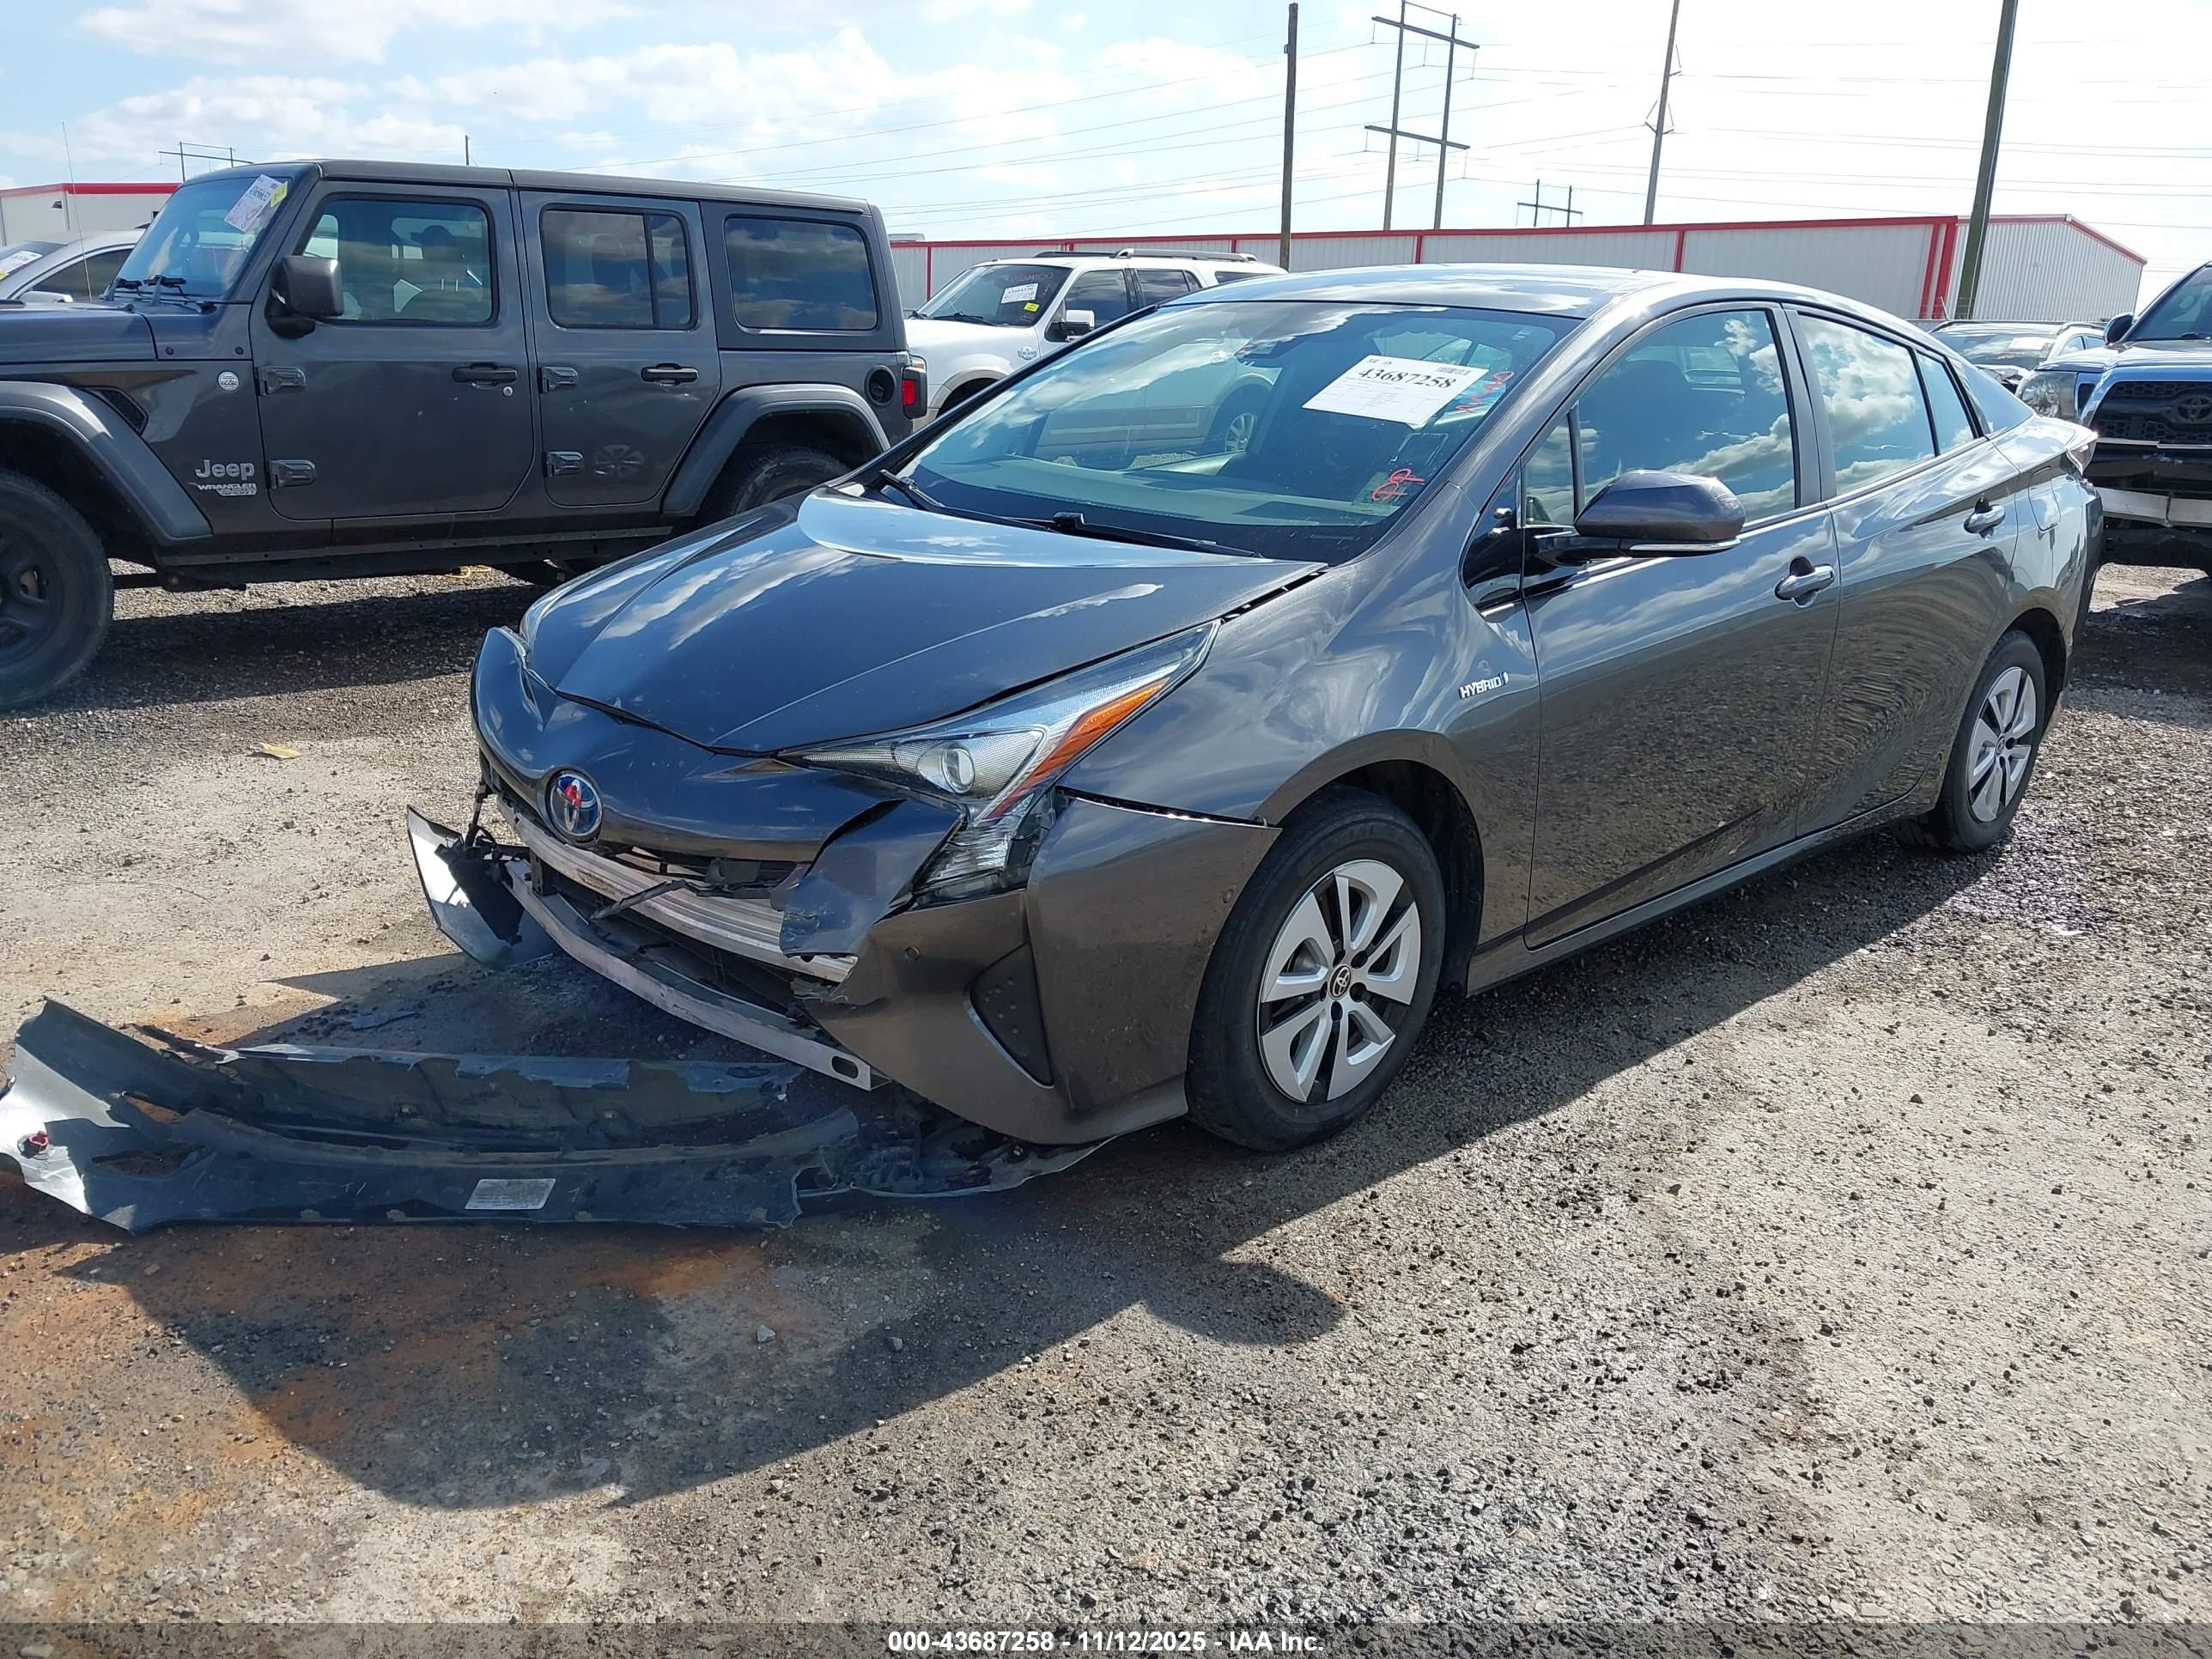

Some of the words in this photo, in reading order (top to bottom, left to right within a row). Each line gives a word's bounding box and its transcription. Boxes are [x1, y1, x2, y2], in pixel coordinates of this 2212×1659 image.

[1357, 368, 1456, 389] 43687258
[195, 459, 254, 480] Jeep
[1459, 677, 1503, 699] HYBRID
